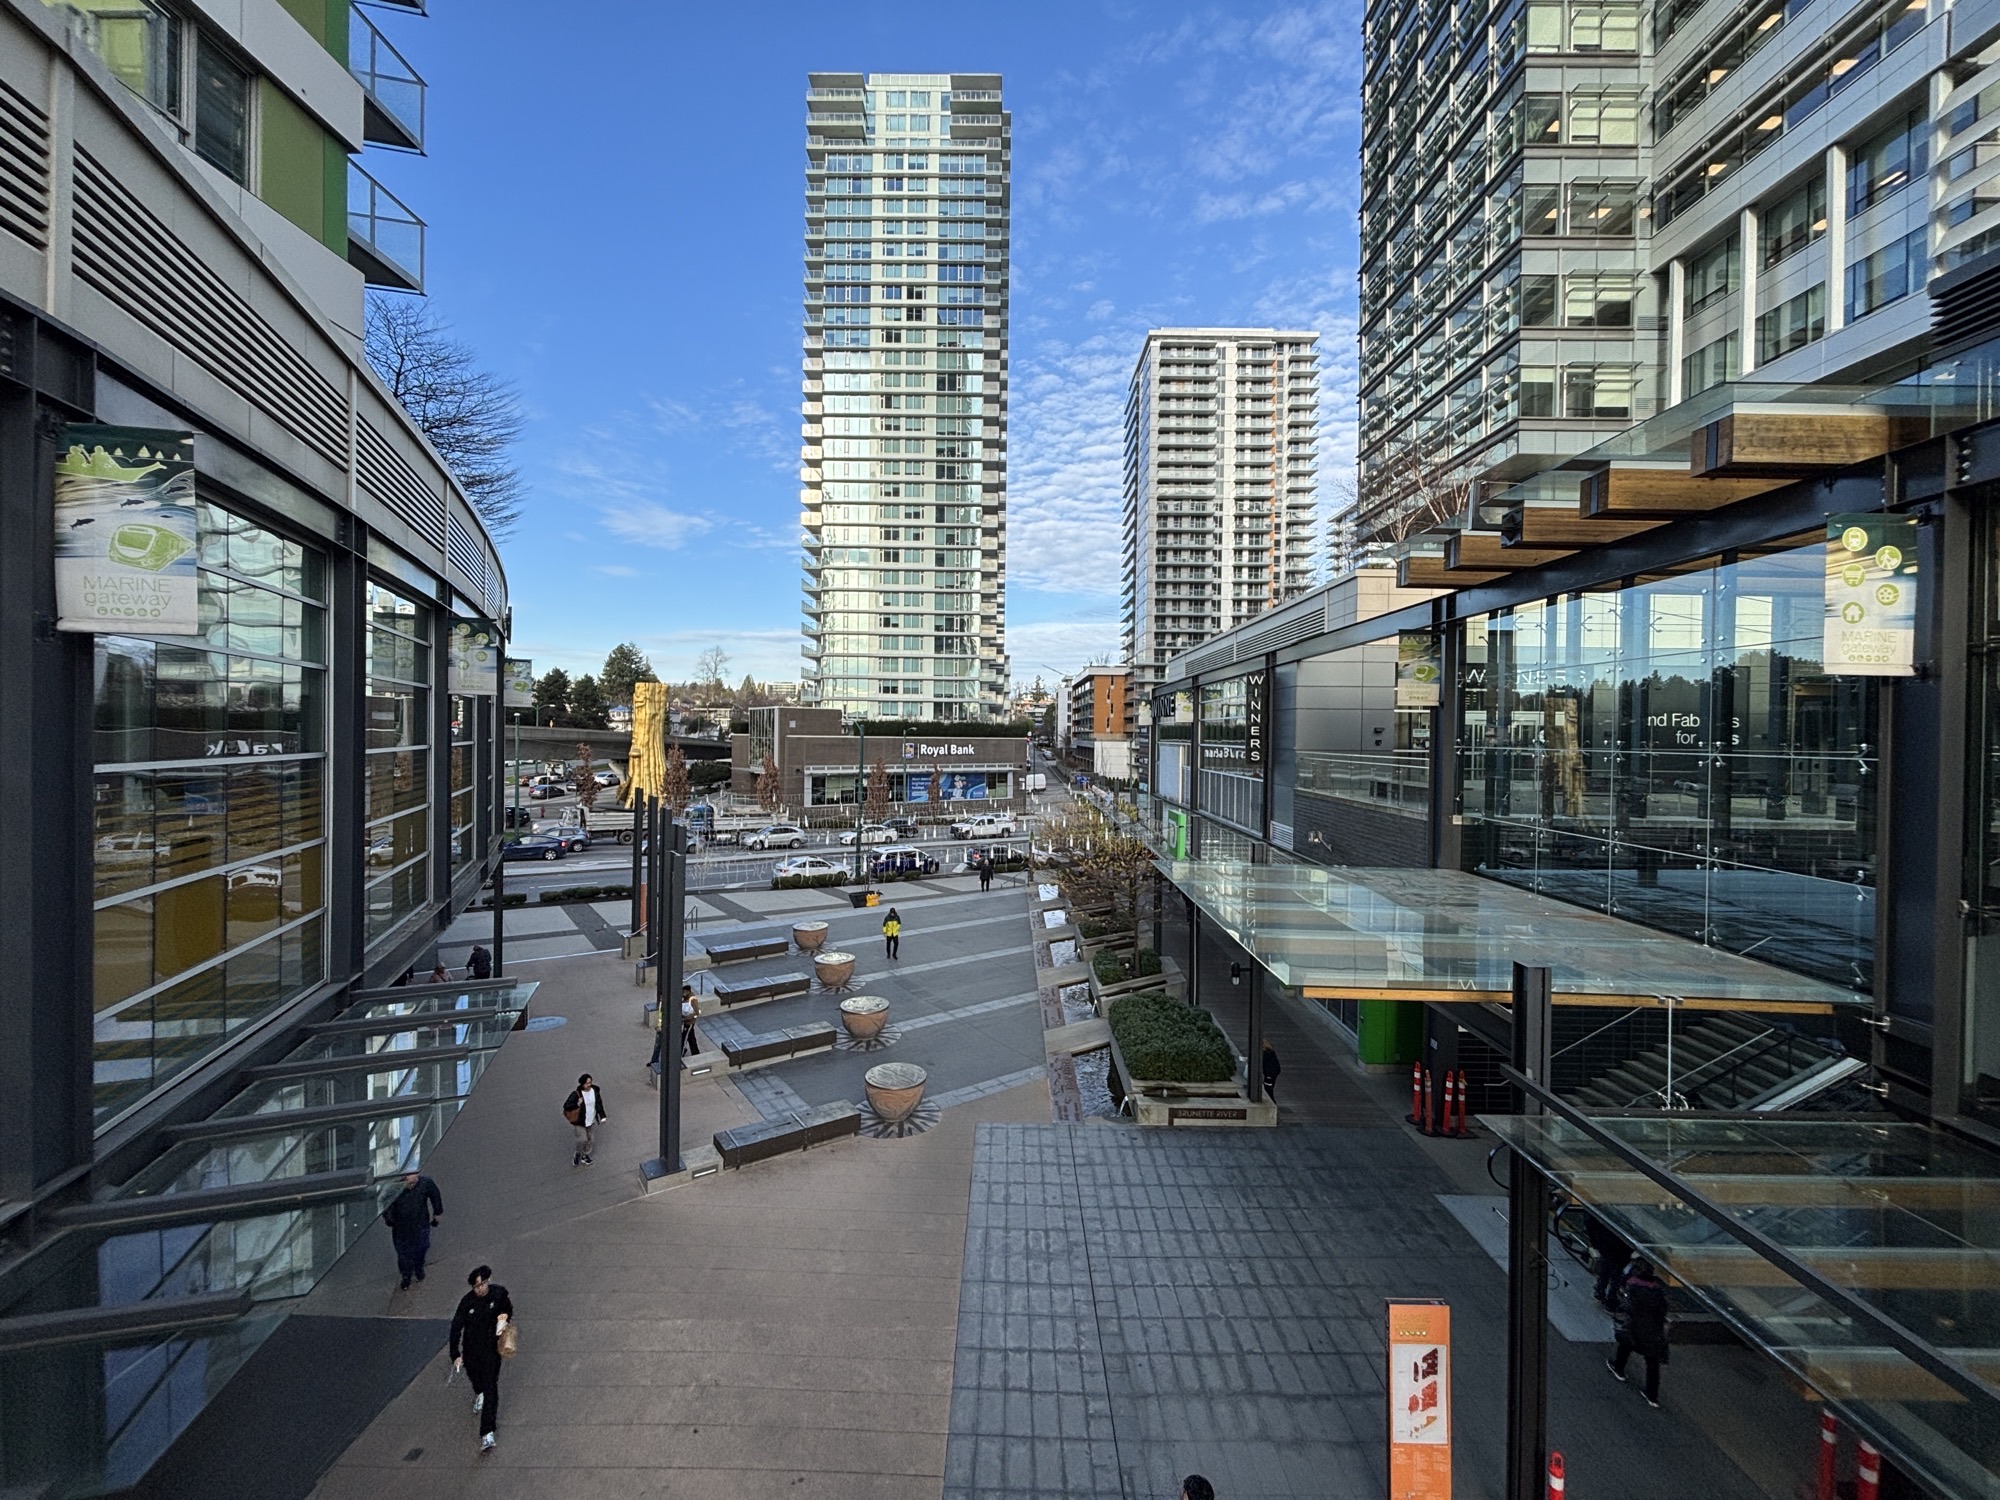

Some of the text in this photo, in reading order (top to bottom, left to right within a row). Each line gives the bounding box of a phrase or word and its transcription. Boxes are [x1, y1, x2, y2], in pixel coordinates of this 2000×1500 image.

[83, 575, 172, 593] MARINE
[83, 591, 172, 610] gateway
[1841, 630, 1898, 644] MARINE
[1841, 642, 1897, 656] gateway
[1152, 695, 1175, 718] WINNE
[1248, 675, 1264, 761] WINNERS
[1647, 713, 1667, 727] nd
[1675, 729, 1697, 745] for
[920, 743, 975, 758] Royal Bank
[1177, 1109, 1238, 1118] BRUNETTE RIVER
